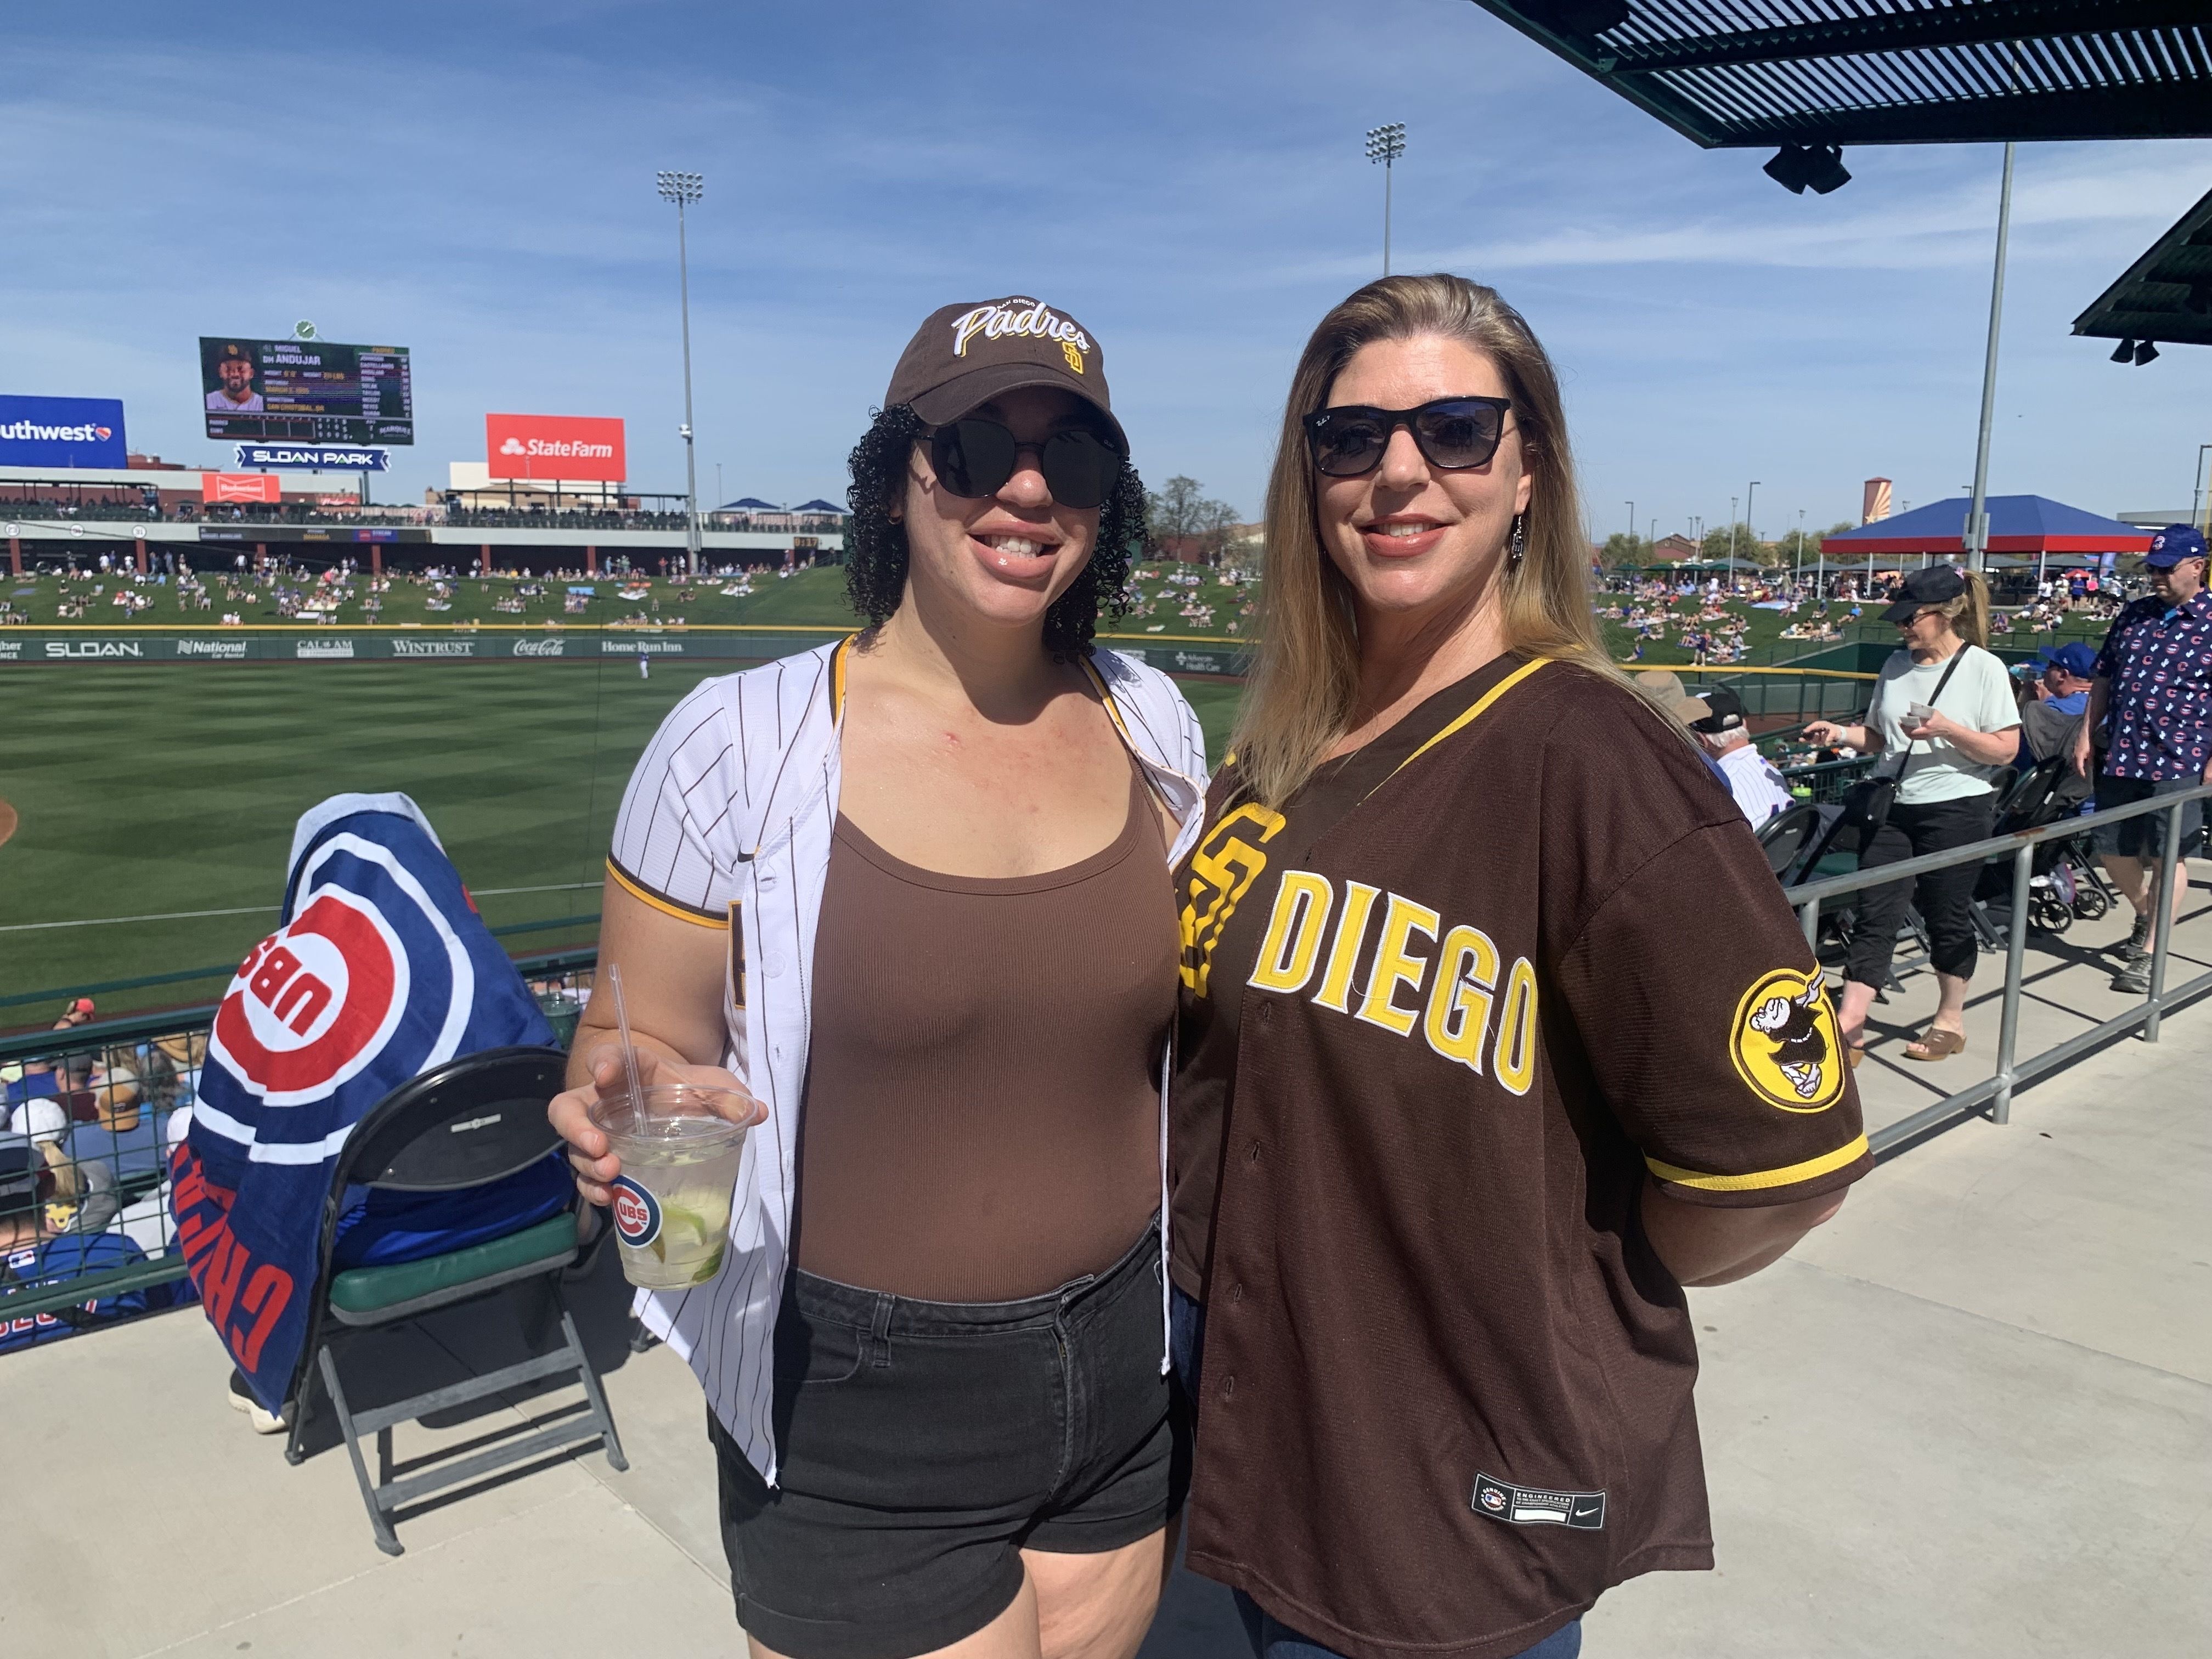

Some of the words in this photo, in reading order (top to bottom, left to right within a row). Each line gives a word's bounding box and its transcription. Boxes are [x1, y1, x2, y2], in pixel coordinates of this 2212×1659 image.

[1013, 298, 1036, 307] DIEGO
[951, 301, 1091, 357] Padres
[275, 354, 321, 366] ANDUJAR
[0, 420, 95, 442] uthwest
[253, 450, 318, 464] SLOAN
[323, 453, 373, 465] PARK
[0, 640, 21, 651] her
[46, 642, 139, 657] SLOAN
[193, 641, 246, 653] National
[334, 640, 353, 648] AM
[393, 639, 473, 653] WINTRUST
[602, 641, 634, 652] Home
[637, 641, 658, 652] Run
[1246, 870, 1538, 1096] DIEGO
[1517, 1492, 1570, 1502] ENGINEERED
